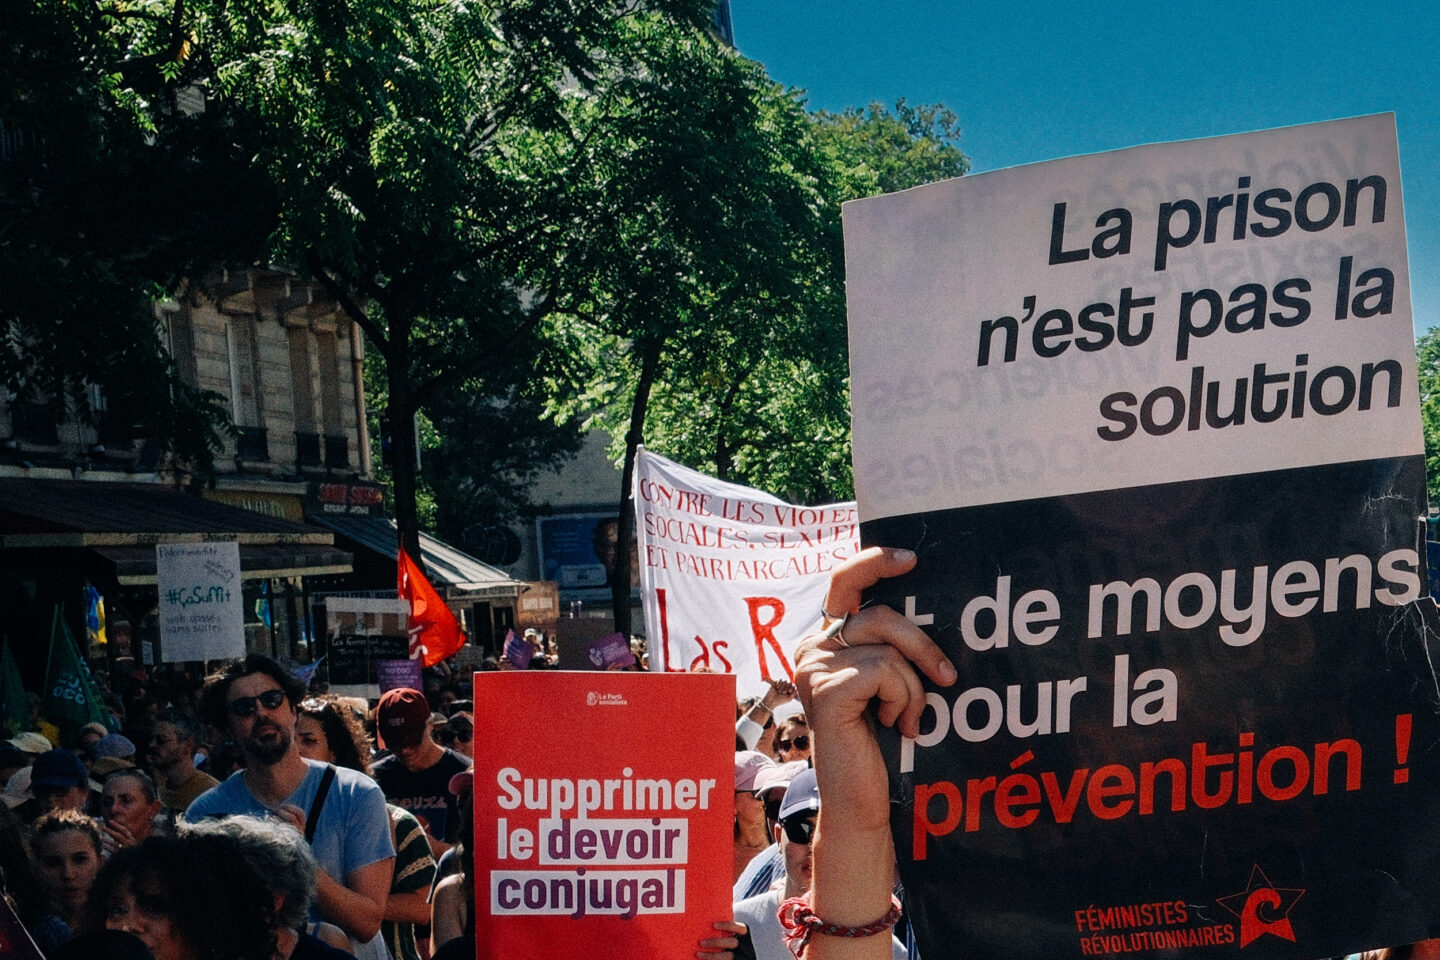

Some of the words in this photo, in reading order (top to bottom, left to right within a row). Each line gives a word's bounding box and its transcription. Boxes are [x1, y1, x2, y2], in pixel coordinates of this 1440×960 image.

[1048, 201, 1133, 267] La
[1154, 173, 1388, 272] prison
[977, 286, 1156, 368] n'est
[1176, 277, 1311, 362] pas
[1334, 255, 1395, 321] la
[1096, 354, 1404, 442] solution
[640, 478, 712, 517] CONTRE
[722, 498, 765, 524] LES
[646, 545, 669, 569] ET
[676, 547, 848, 581] PATRIARCALES
[960, 575, 1061, 651] de
[1087, 547, 1422, 647] moyens
[900, 676, 1087, 774] pour
[1111, 653, 1180, 728] la
[497, 767, 716, 820] Supprimer
[912, 732, 1363, 862] prévention
[1393, 713, 1413, 785] !
[498, 818, 534, 860] le
[548, 817, 681, 860] devoir
[498, 867, 676, 920] conjugal
[1074, 900, 1189, 933] FÉMINISTES
[1079, 924, 1235, 956] RÉVOLUTIONNAIRES
